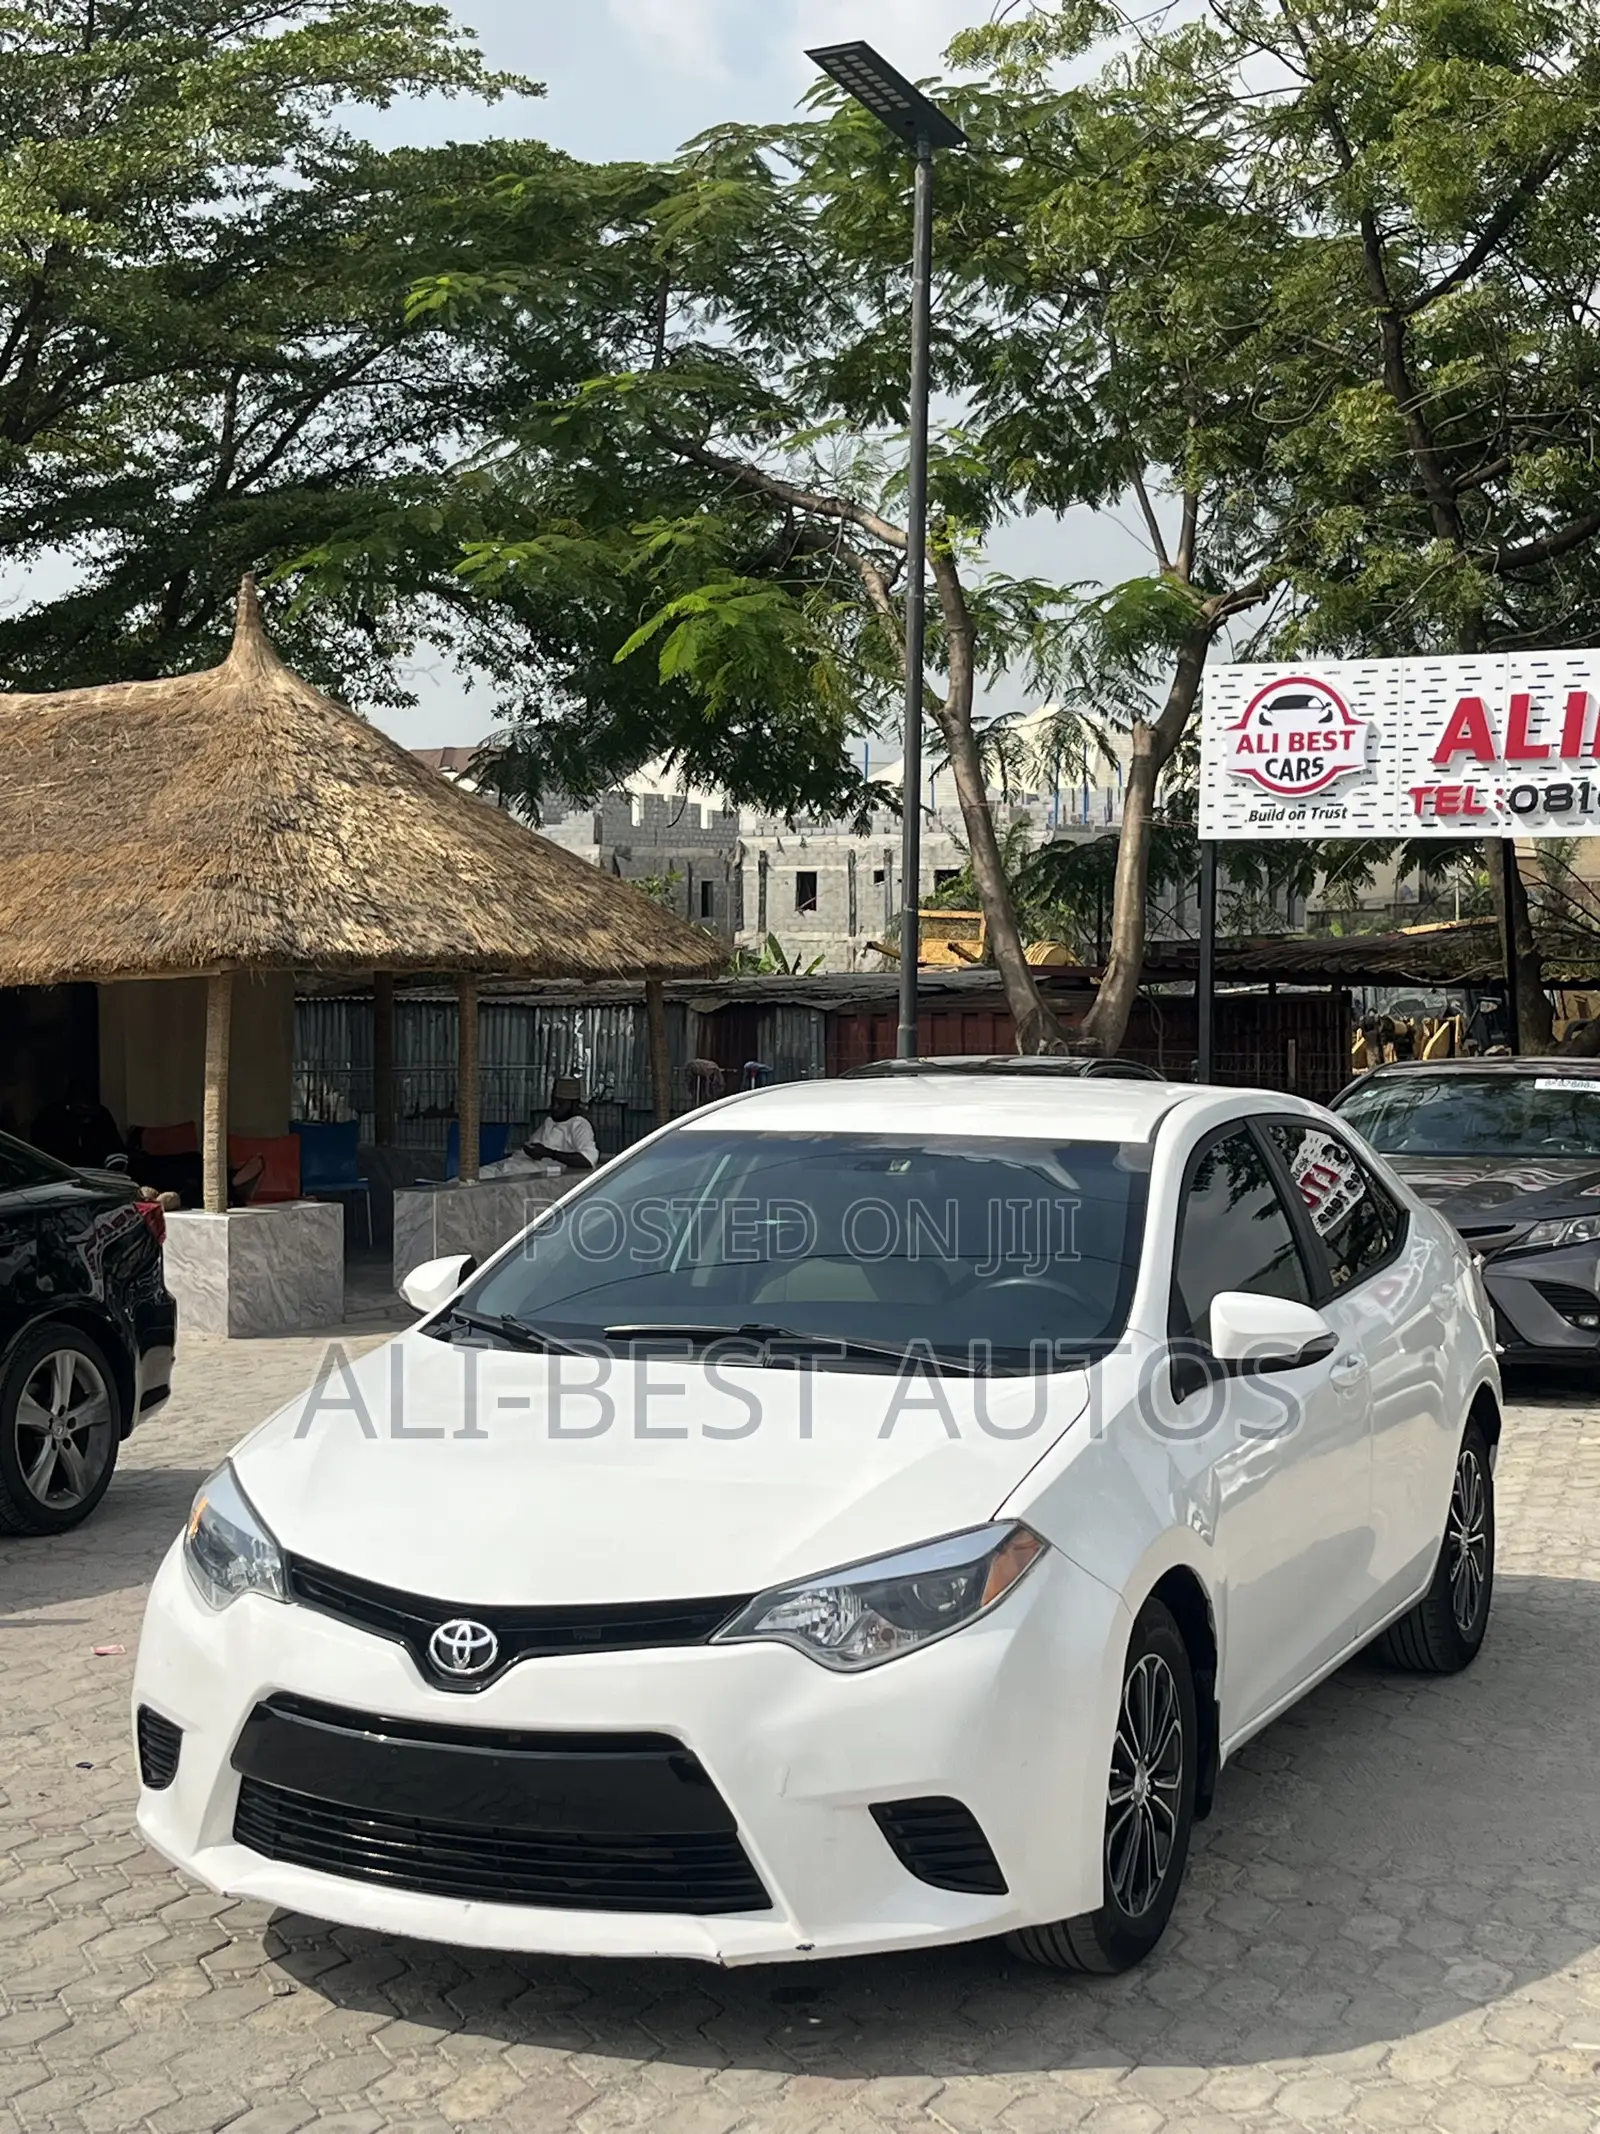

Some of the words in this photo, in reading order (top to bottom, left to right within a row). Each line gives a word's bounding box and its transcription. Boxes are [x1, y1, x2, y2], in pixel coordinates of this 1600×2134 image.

[1432, 690, 1600, 764] ALI
[1236, 733, 1279, 754] ALI
[1288, 730, 1356, 752] BEST
[1264, 757, 1325, 782] CARS
[1508, 781, 1600, 814] 081
[1248, 808, 1286, 823] Build
[1288, 812, 1307, 821] on
[1311, 806, 1349, 820] Trust
